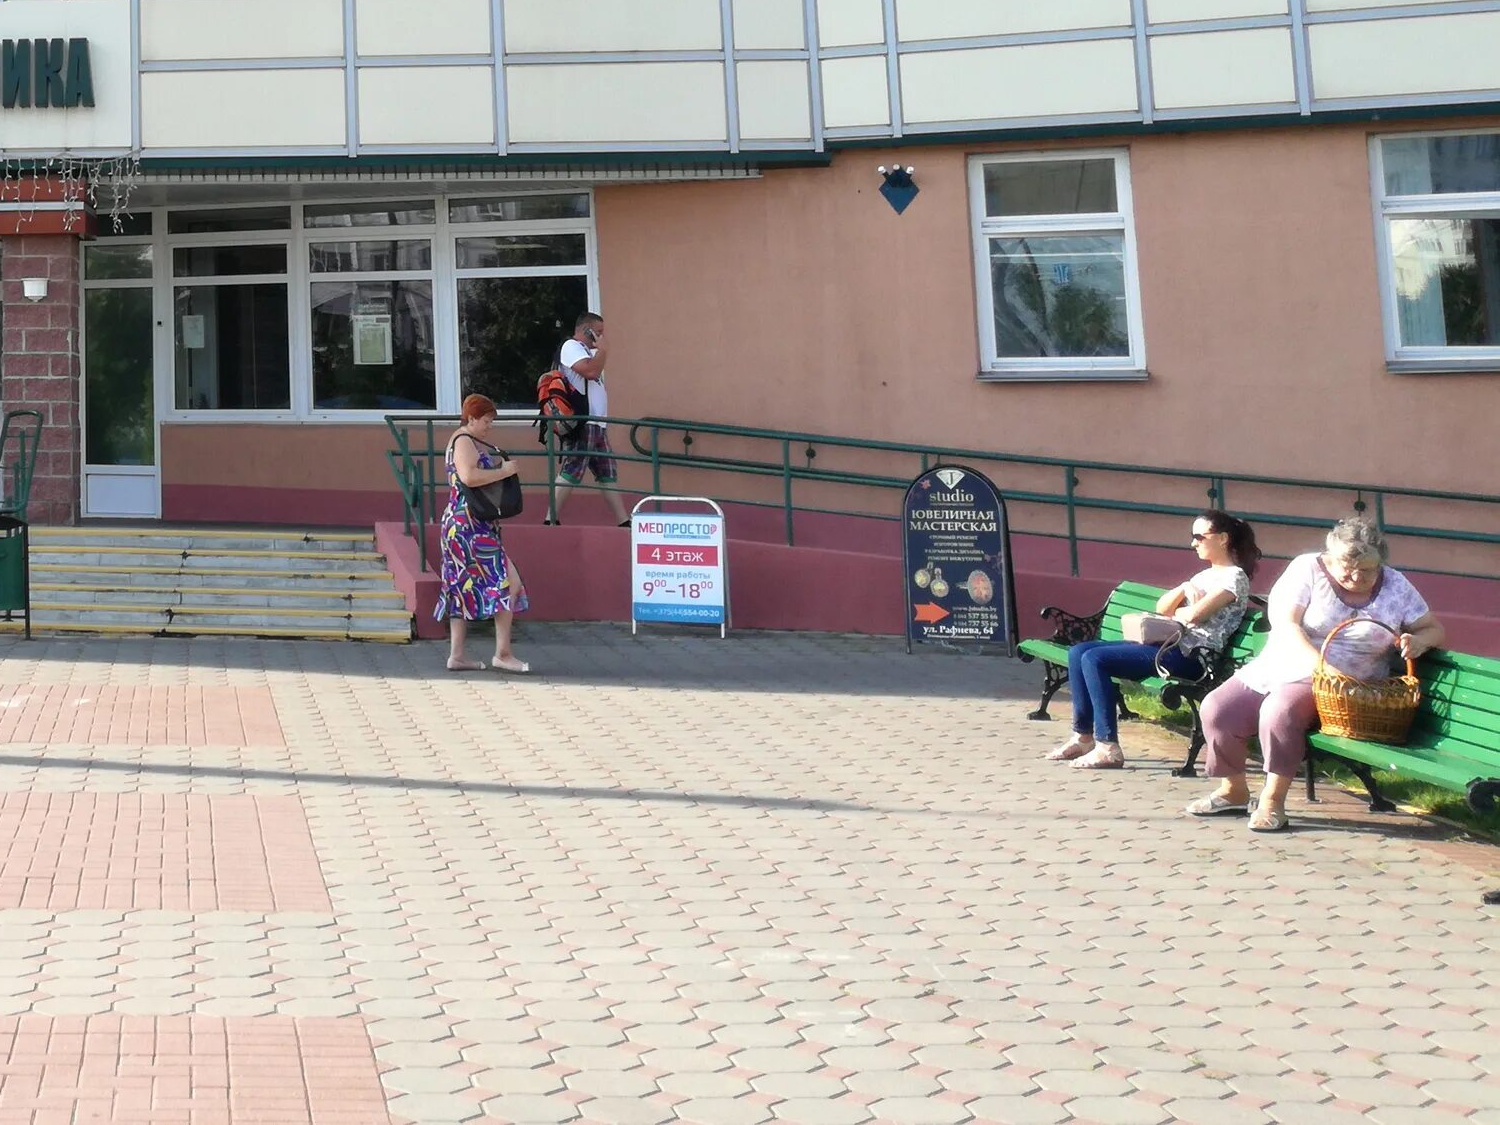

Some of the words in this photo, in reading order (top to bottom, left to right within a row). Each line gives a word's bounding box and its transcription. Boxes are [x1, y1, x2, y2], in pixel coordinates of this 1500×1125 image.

[929, 489, 974, 502] studio
[911, 509, 995, 521] ЮВЕЛИРНАЯ
[910, 521, 998, 532] МАСТЕРСКАЯ
[651, 547, 662, 562] 4
[666, 551, 704, 563] этаж
[645, 571, 674, 579] время
[676, 571, 711, 580] работы
[923, 626, 938, 635] ул.
[983, 626, 994, 635] 64
